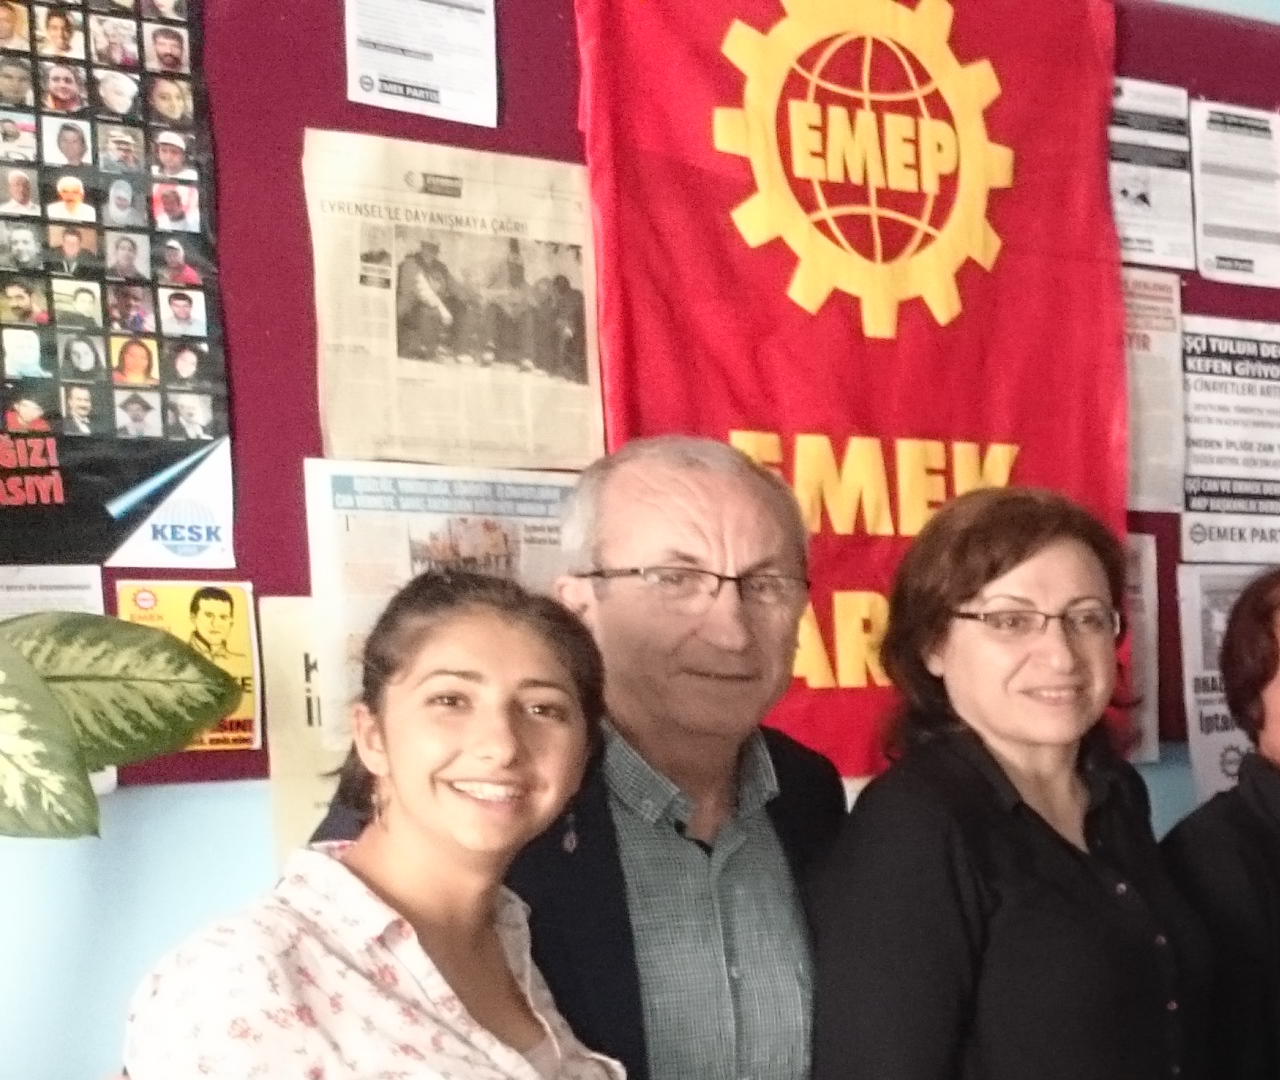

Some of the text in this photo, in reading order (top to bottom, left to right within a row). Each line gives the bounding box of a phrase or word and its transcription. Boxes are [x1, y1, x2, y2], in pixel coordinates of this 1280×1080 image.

[788, 100, 961, 196] EMEP
[1209, 337, 1258, 357] TULUM
[1186, 357, 1231, 375] KEFEN
[1194, 378, 1257, 396] CİNAYETLERİ
[150, 523, 223, 542] KESK
[1209, 526, 1247, 543] EMEK
